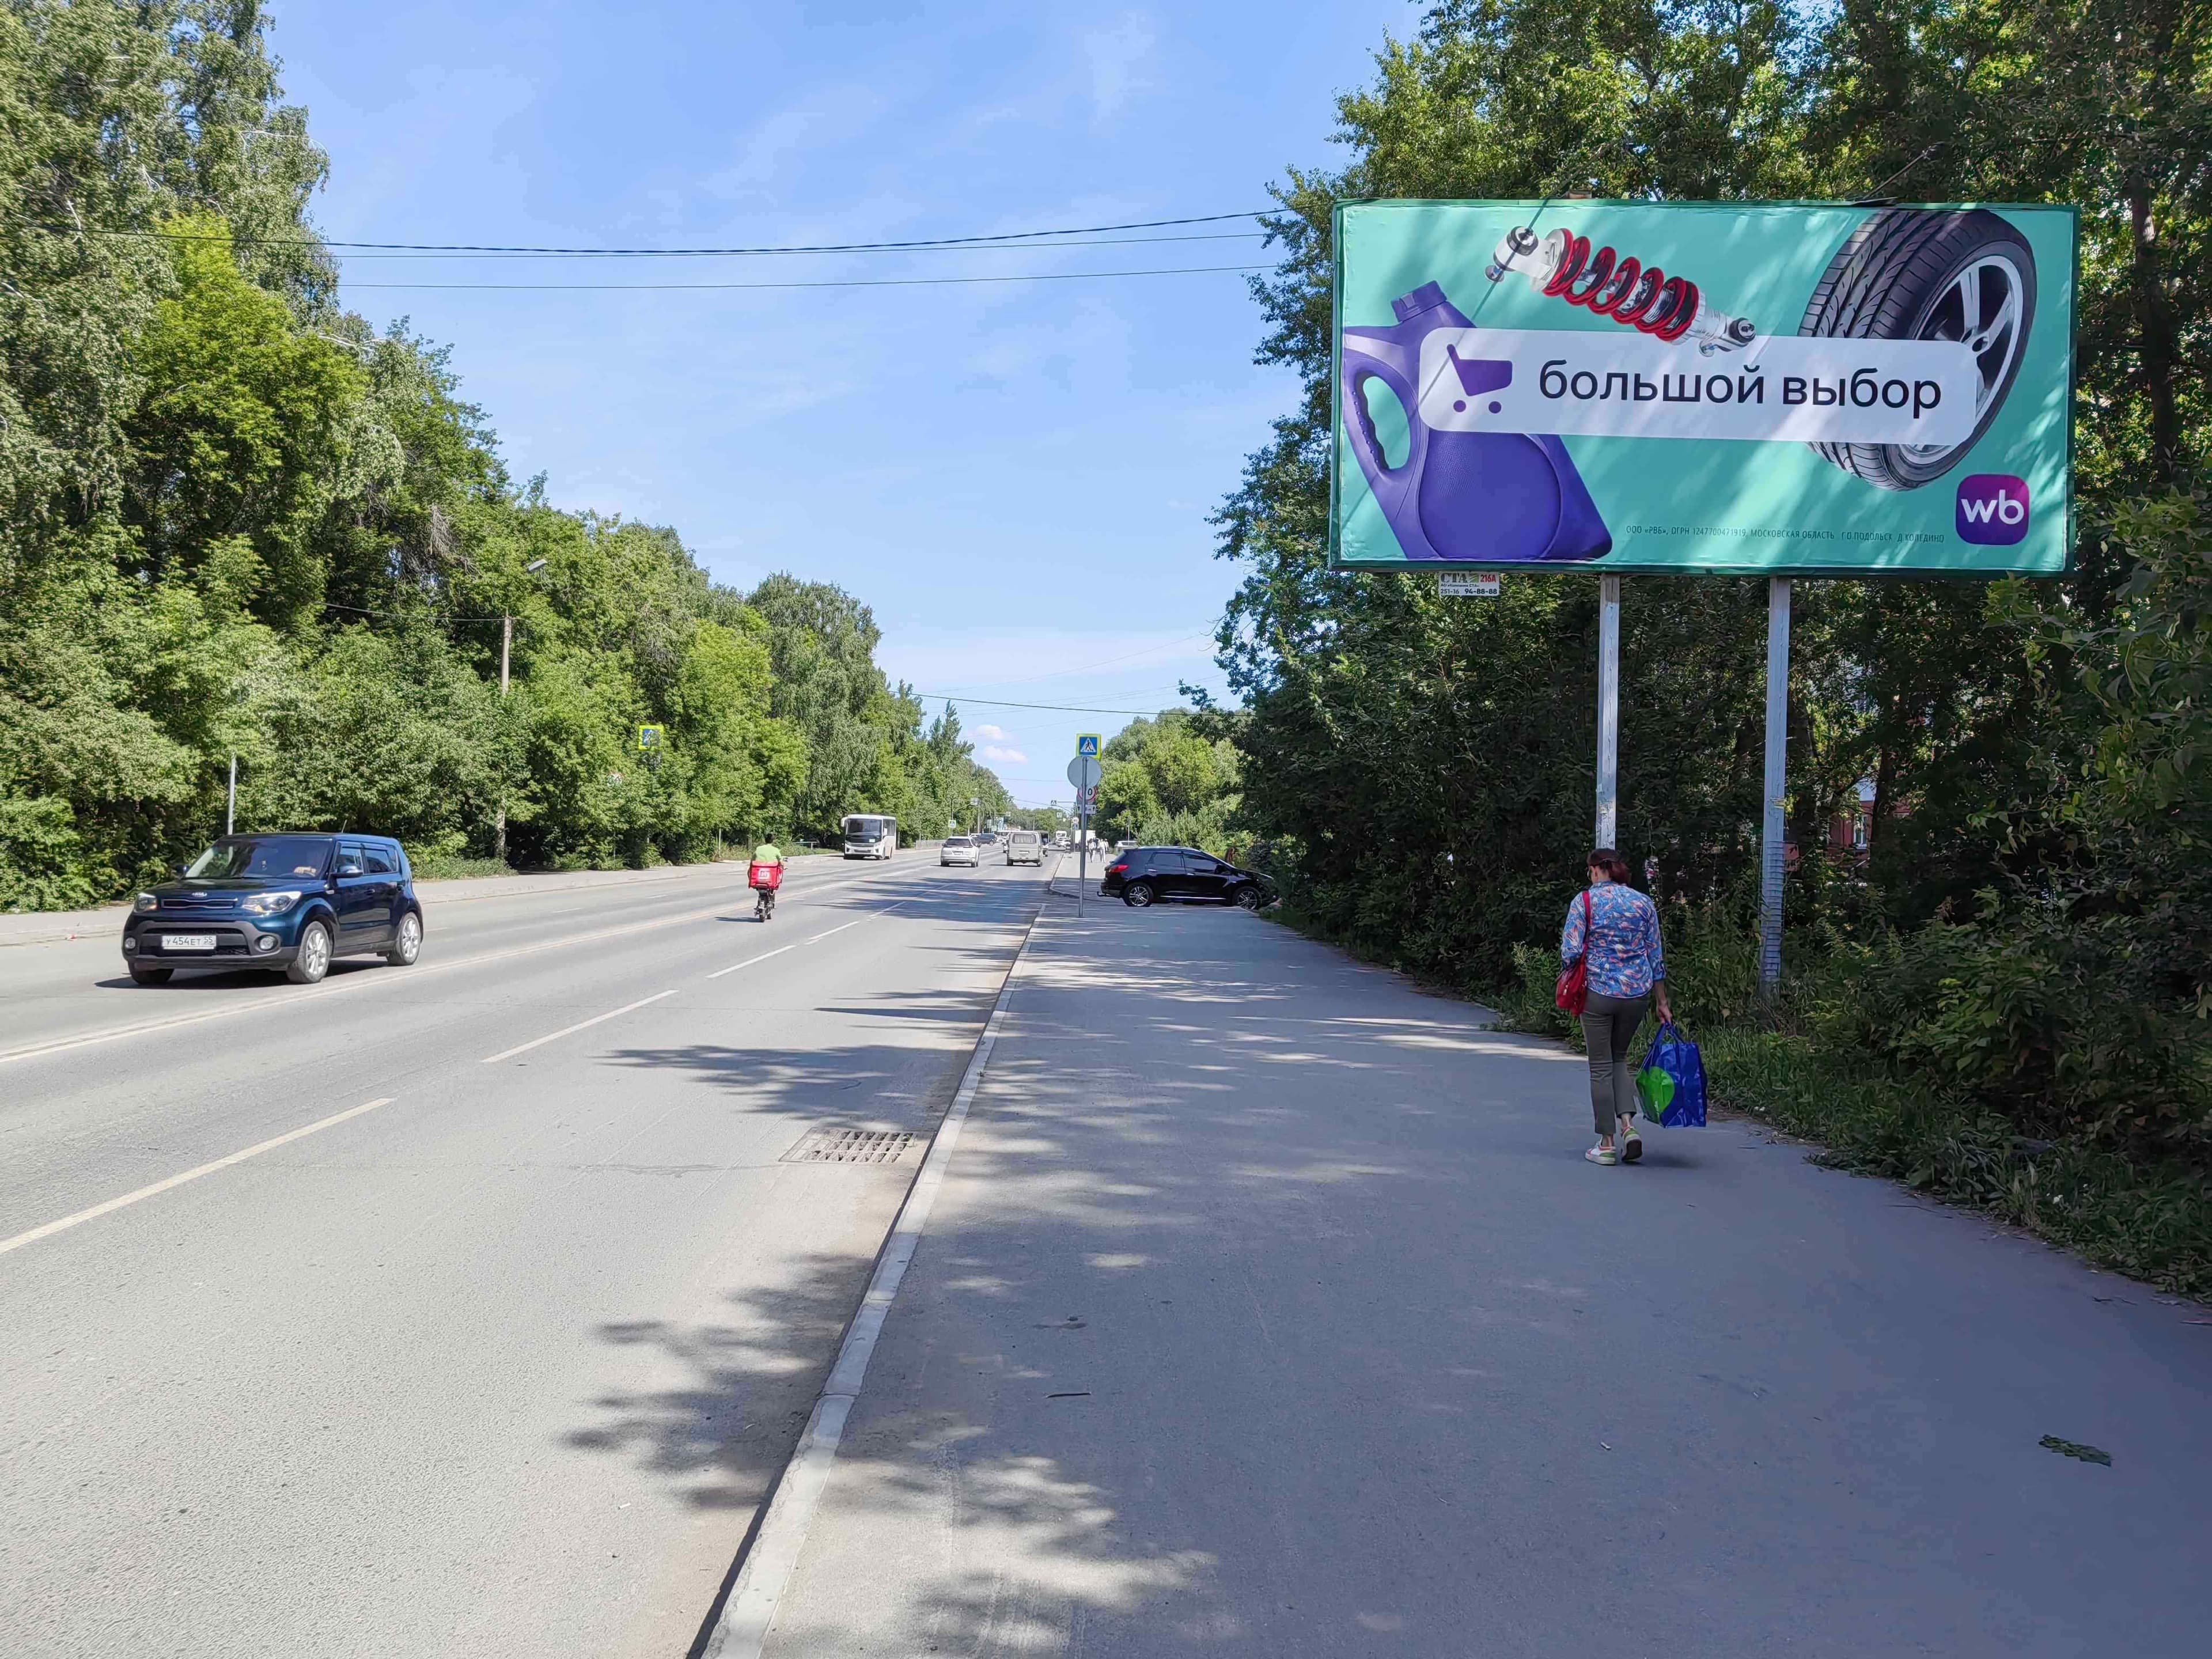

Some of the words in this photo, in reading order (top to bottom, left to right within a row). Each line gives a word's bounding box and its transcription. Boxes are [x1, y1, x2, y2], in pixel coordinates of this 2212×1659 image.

[1540, 359, 1764, 404] большой
[1783, 368, 1941, 419] выбор
[1961, 489, 2024, 525] wb
[1626, 525, 1642, 534] ООО
[1671, 527, 1690, 535] ОГРН
[1751, 528, 1800, 538] МОСКОВСКАЯ
[1440, 573, 1468, 583] СТА
